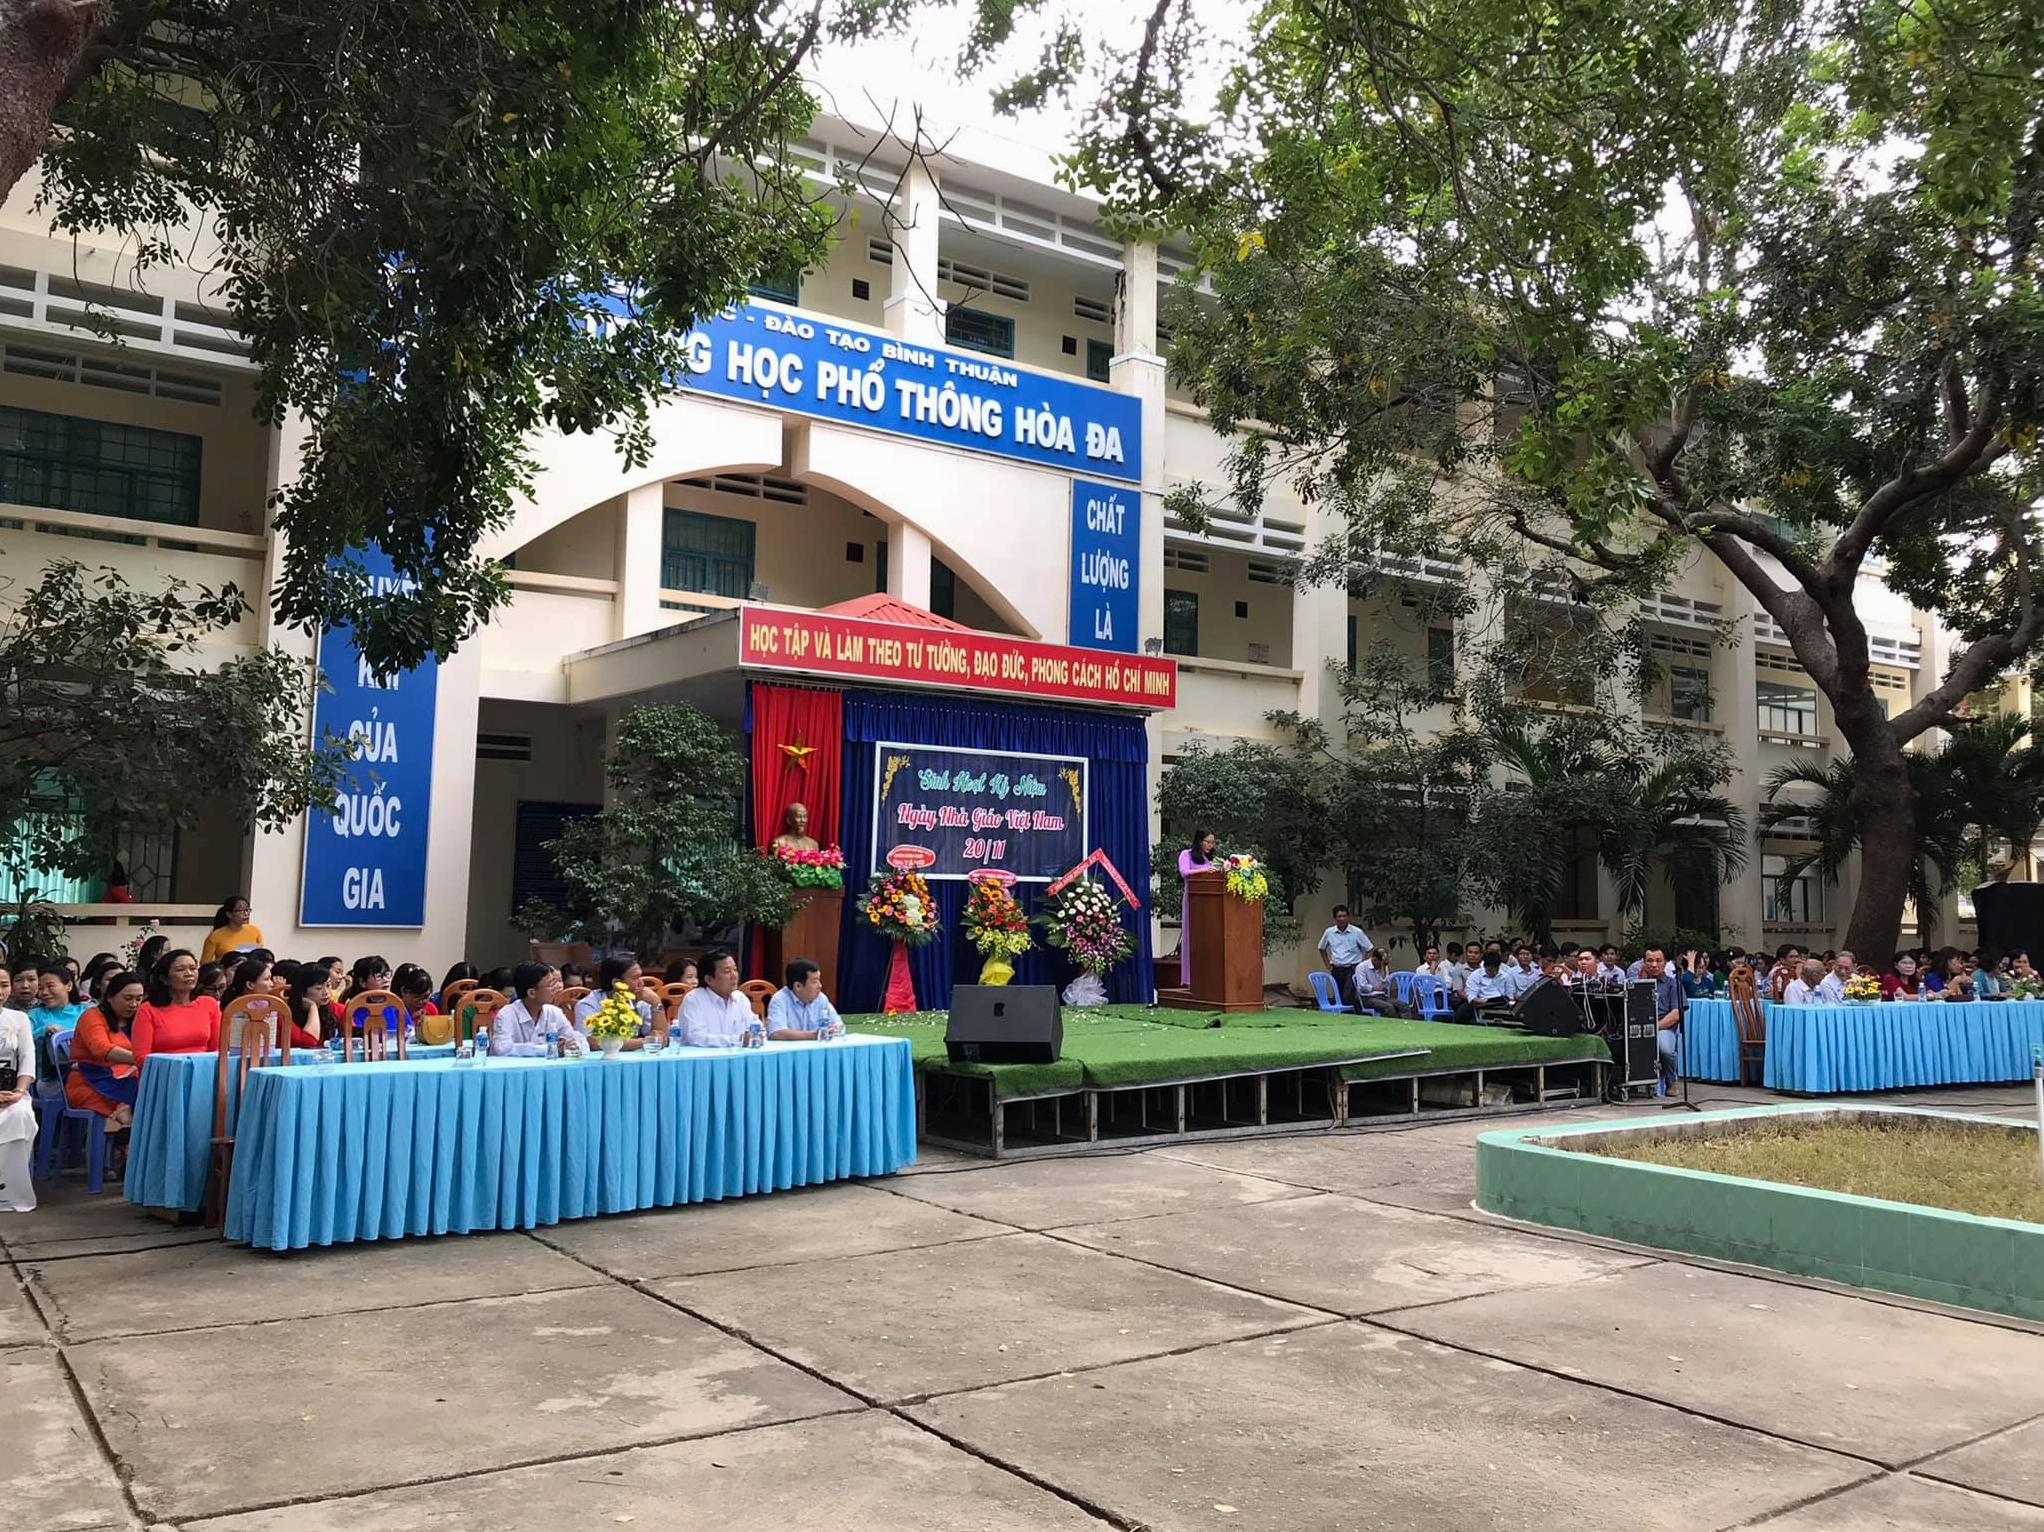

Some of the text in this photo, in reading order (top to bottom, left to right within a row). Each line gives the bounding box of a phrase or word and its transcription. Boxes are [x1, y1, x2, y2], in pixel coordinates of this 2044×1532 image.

[764, 315, 815, 340] ĐÀO
[825, 329, 871, 353] TẠO
[882, 342, 935, 369] BÌNH
[945, 358, 1018, 388] THUẬN
[727, 340, 804, 399] HỌC
[817, 357, 886, 412] PHỔ
[895, 380, 1003, 438] THÔNG
[1014, 401, 1076, 453] HÒA
[1085, 422, 1125, 463] ĐA
[1086, 493, 1125, 535] CHẤT
[1081, 549, 1129, 593] LƯỢNG
[1095, 602, 1113, 641] LÀ
[750, 622, 1170, 696] HỌC TẬP VÀ LÀM THEO TƯ TƯỞNG, ĐẠO ĐỨC, PHONG CÁCH HỒ CHÍ MINH
[348, 706, 398, 763] CỦA
[332, 782, 402, 839] QUỐC
[898, 802, 1065, 833] Ngày Nhà Giáo Việt Nam
[962, 837, 1007, 865] 20/11
[342, 867, 386, 909] GIA
